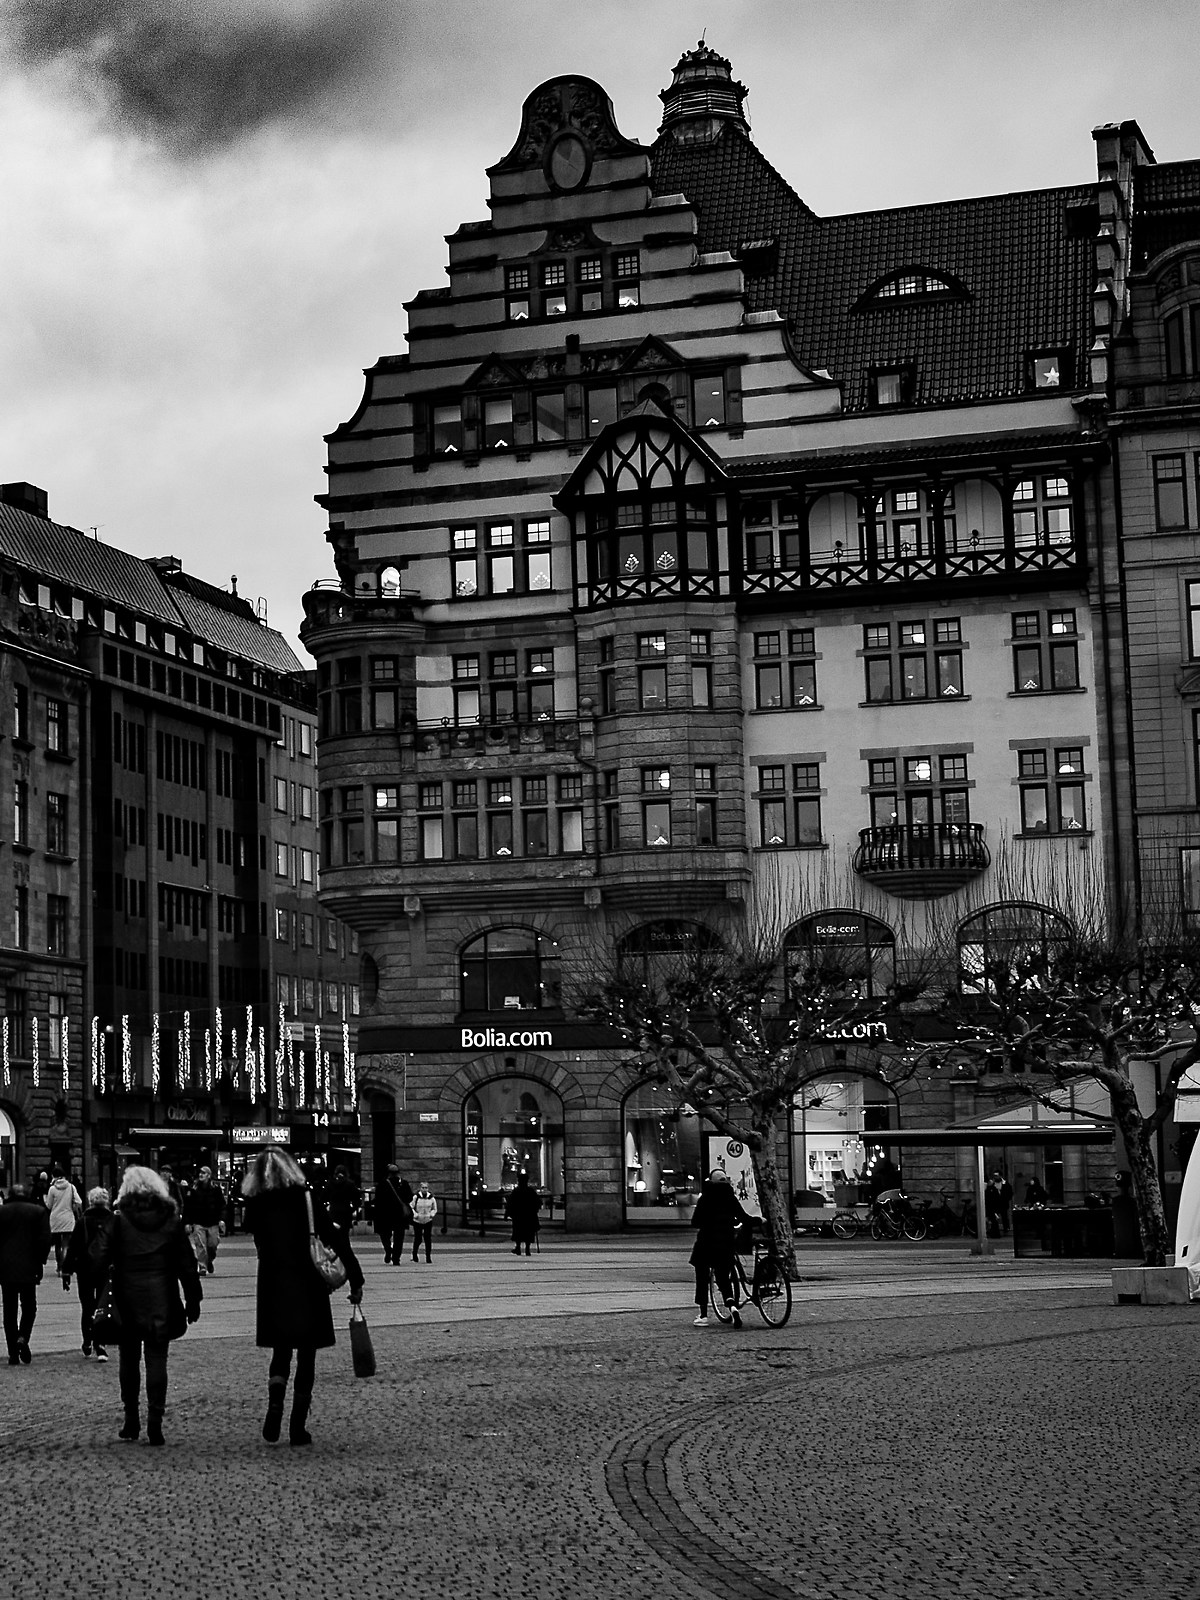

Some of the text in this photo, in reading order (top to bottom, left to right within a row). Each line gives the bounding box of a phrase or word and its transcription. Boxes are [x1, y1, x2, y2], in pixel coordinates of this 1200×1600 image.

[461, 1027, 553, 1048] Bolia.com
[312, 1112, 330, 1127] 14
[729, 1143, 741, 1153] 40
